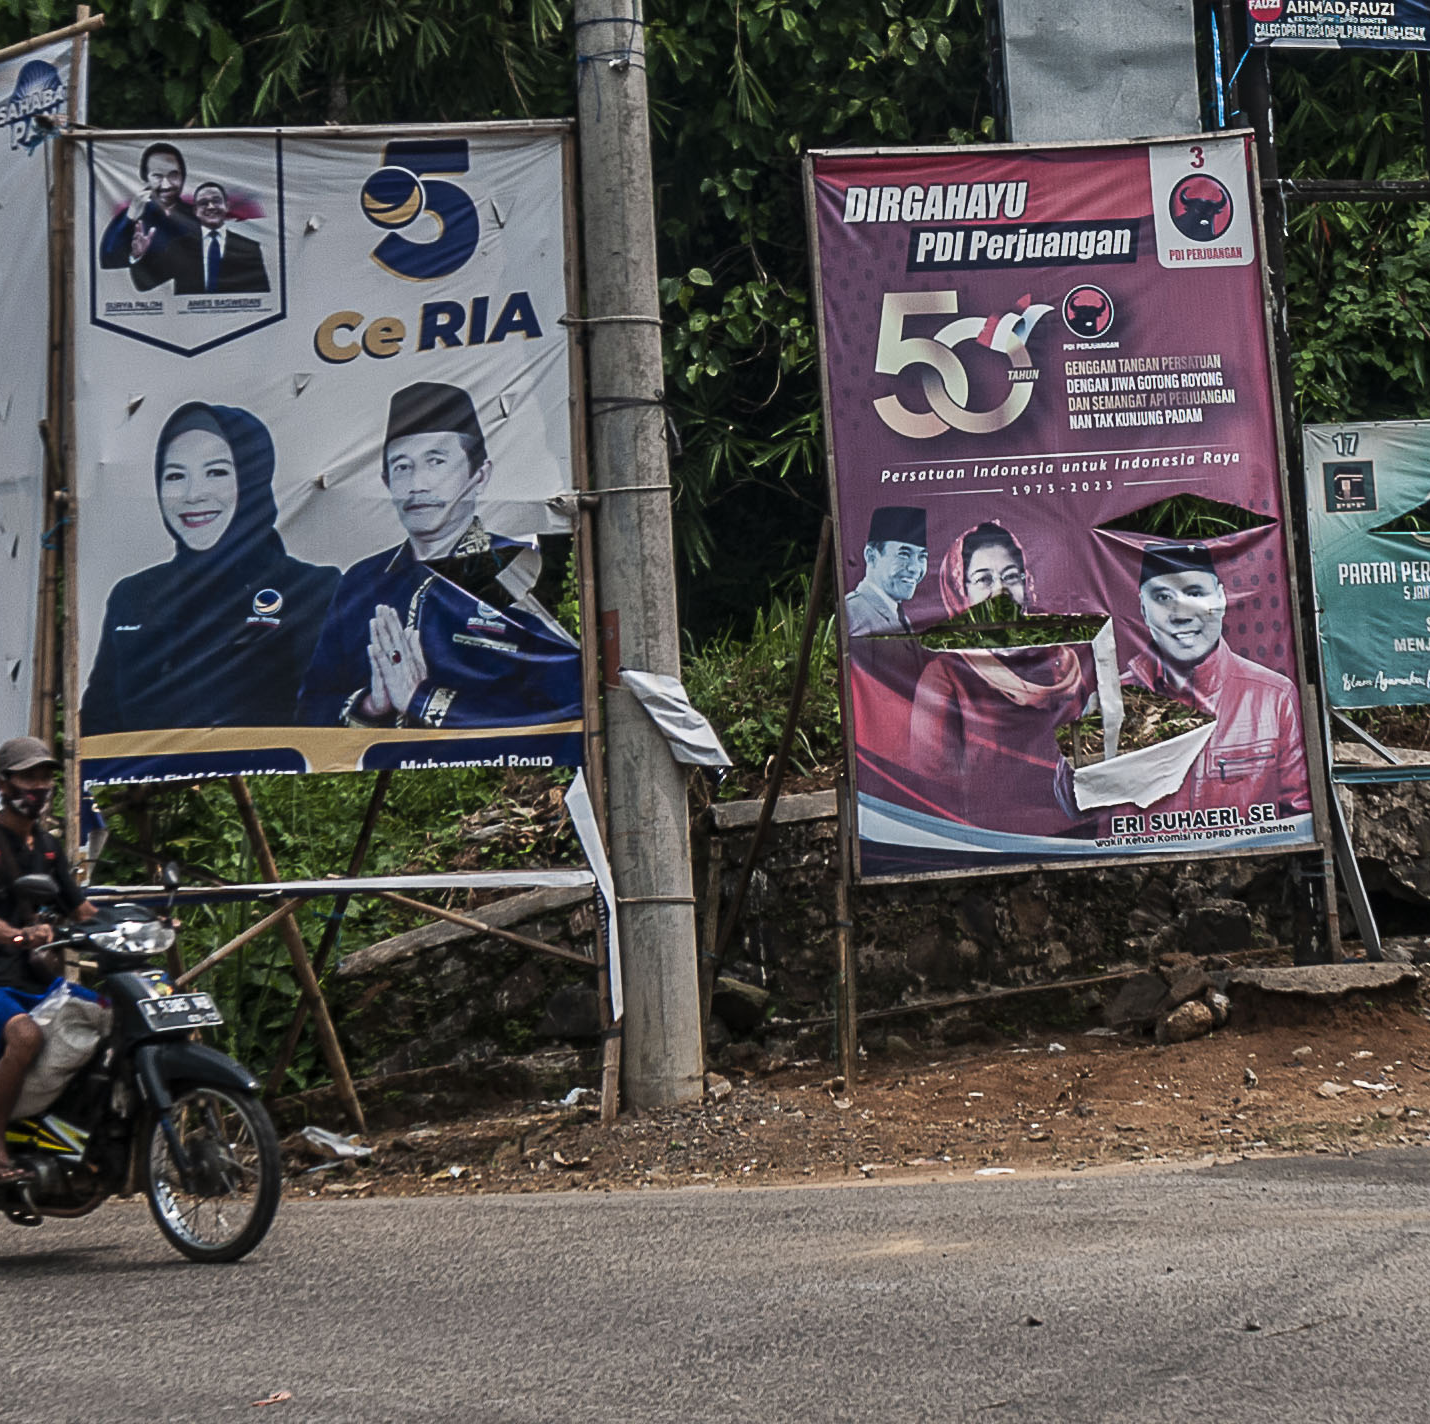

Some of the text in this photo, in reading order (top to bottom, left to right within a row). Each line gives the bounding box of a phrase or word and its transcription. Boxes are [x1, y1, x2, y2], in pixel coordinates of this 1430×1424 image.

[1286, 0, 1396, 17] AHMAD FAUZI
[1189, 145, 1205, 169] 3
[371, 139, 480, 282] 5
[842, 181, 1029, 224] DIRGAHAYU
[915, 226, 1131, 264] PDI Perjuangan
[1168, 246, 1244, 262] PDI PERJUANGAN
[1075, 341, 1120, 350] PERJUANGAN
[1007, 369, 1039, 381] TAHUN
[1064, 354, 1221, 376] GENGGAM TANGAN PERSATUAN
[1066, 371, 1224, 394] DENGAN JIWA GOTONG ROYONG
[1068, 389, 1236, 412] DAN SEMANGAT API PERJUANGAN
[1069, 407, 1204, 430] NAN TAK KUNJUNG PADAM
[1331, 431, 1359, 456] 17
[880, 450, 1241, 483] Persatuan Indonesia untuk Indonesia Raya
[1011, 480, 1114, 496] 1973-2023
[1337, 561, 1396, 586] PARTAI
[1403, 586, 1411, 600] 5
[1111, 803, 1276, 834] ERI SUHAERI, SE
[1095, 837, 1123, 848] Wakil
[1125, 835, 1155, 846] Ketua
[1157, 832, 1191, 843] Komisi
[1193, 831, 1203, 841] IV
[1206, 829, 1232, 840] DPRD
